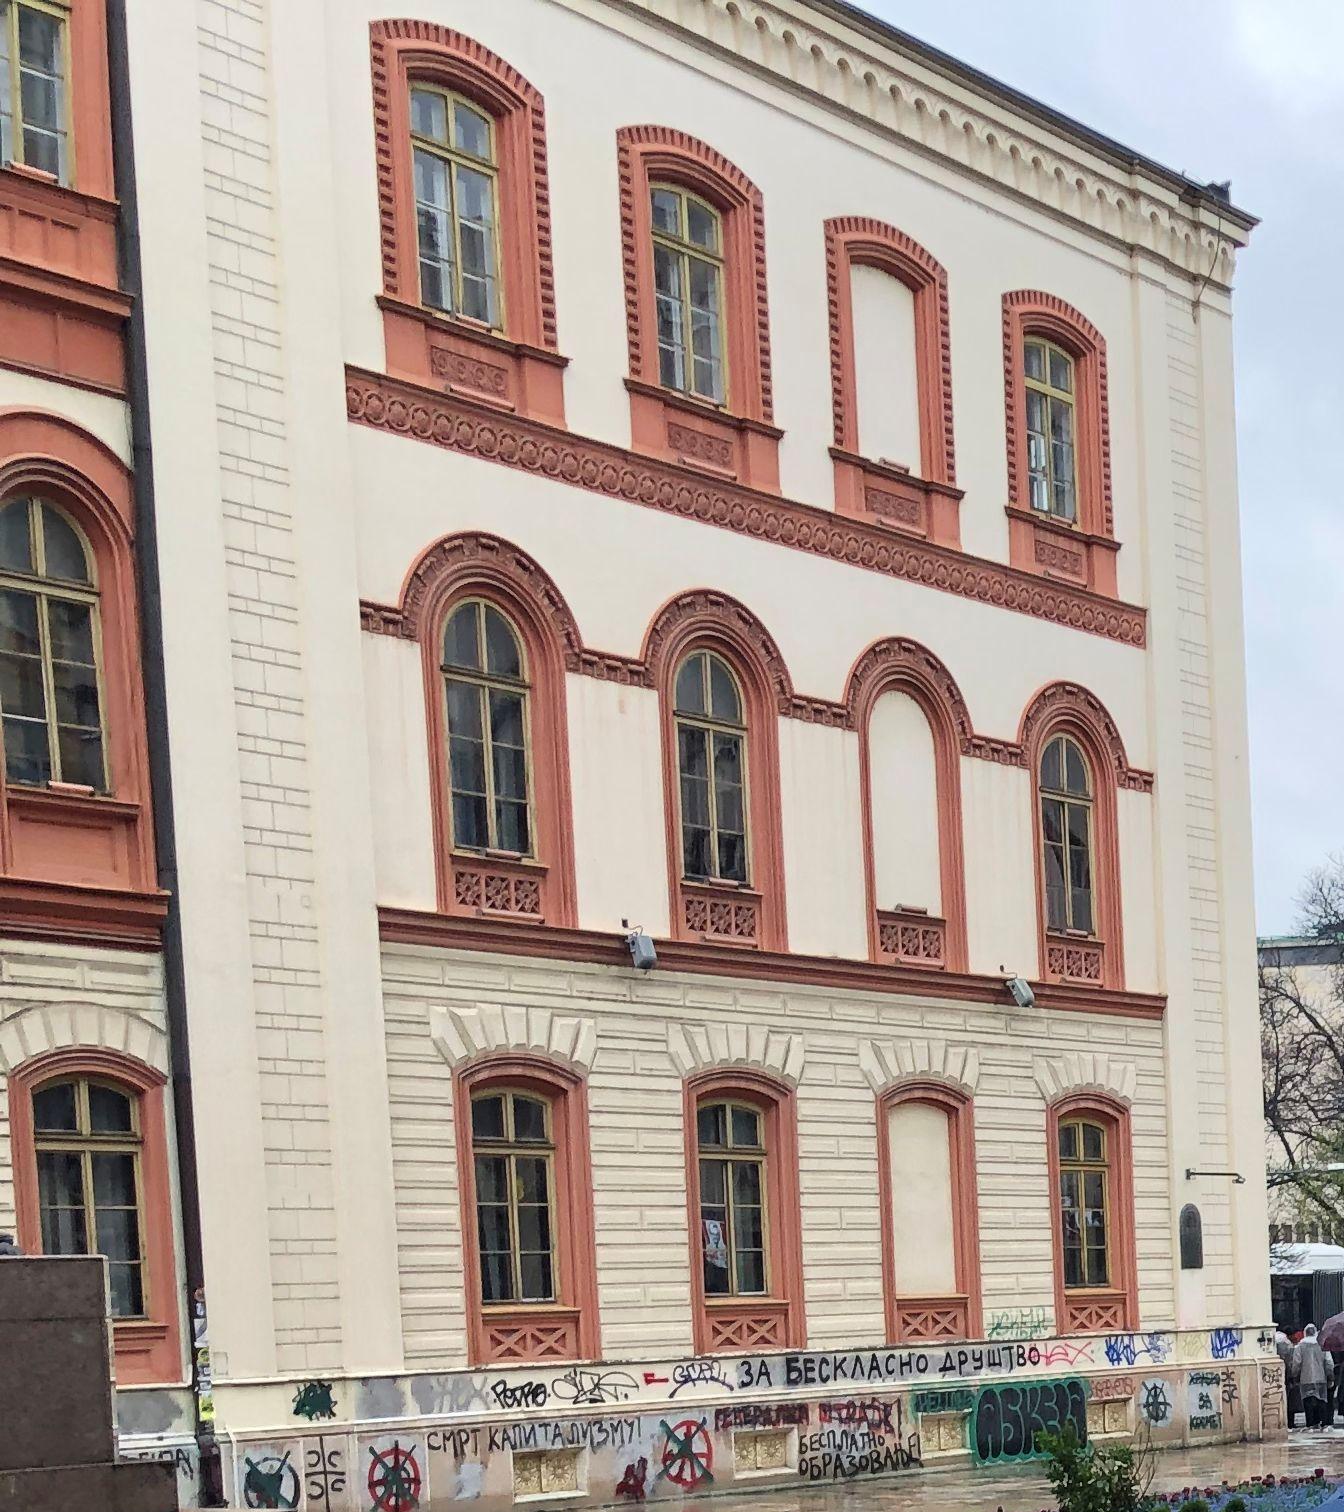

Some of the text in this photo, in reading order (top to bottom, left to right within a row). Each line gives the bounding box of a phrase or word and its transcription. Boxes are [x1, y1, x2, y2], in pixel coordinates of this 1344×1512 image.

[738, 1359, 773, 1389] ЗА
[785, 1351, 929, 1386] БЕСКЛАСНО
[938, 1344, 1041, 1376] ДРУШТВО
[427, 1416, 642, 1457] СМРТ КАПИТАЛИЗМУ!
[799, 1429, 886, 1455] БЕСПЛАТНО
